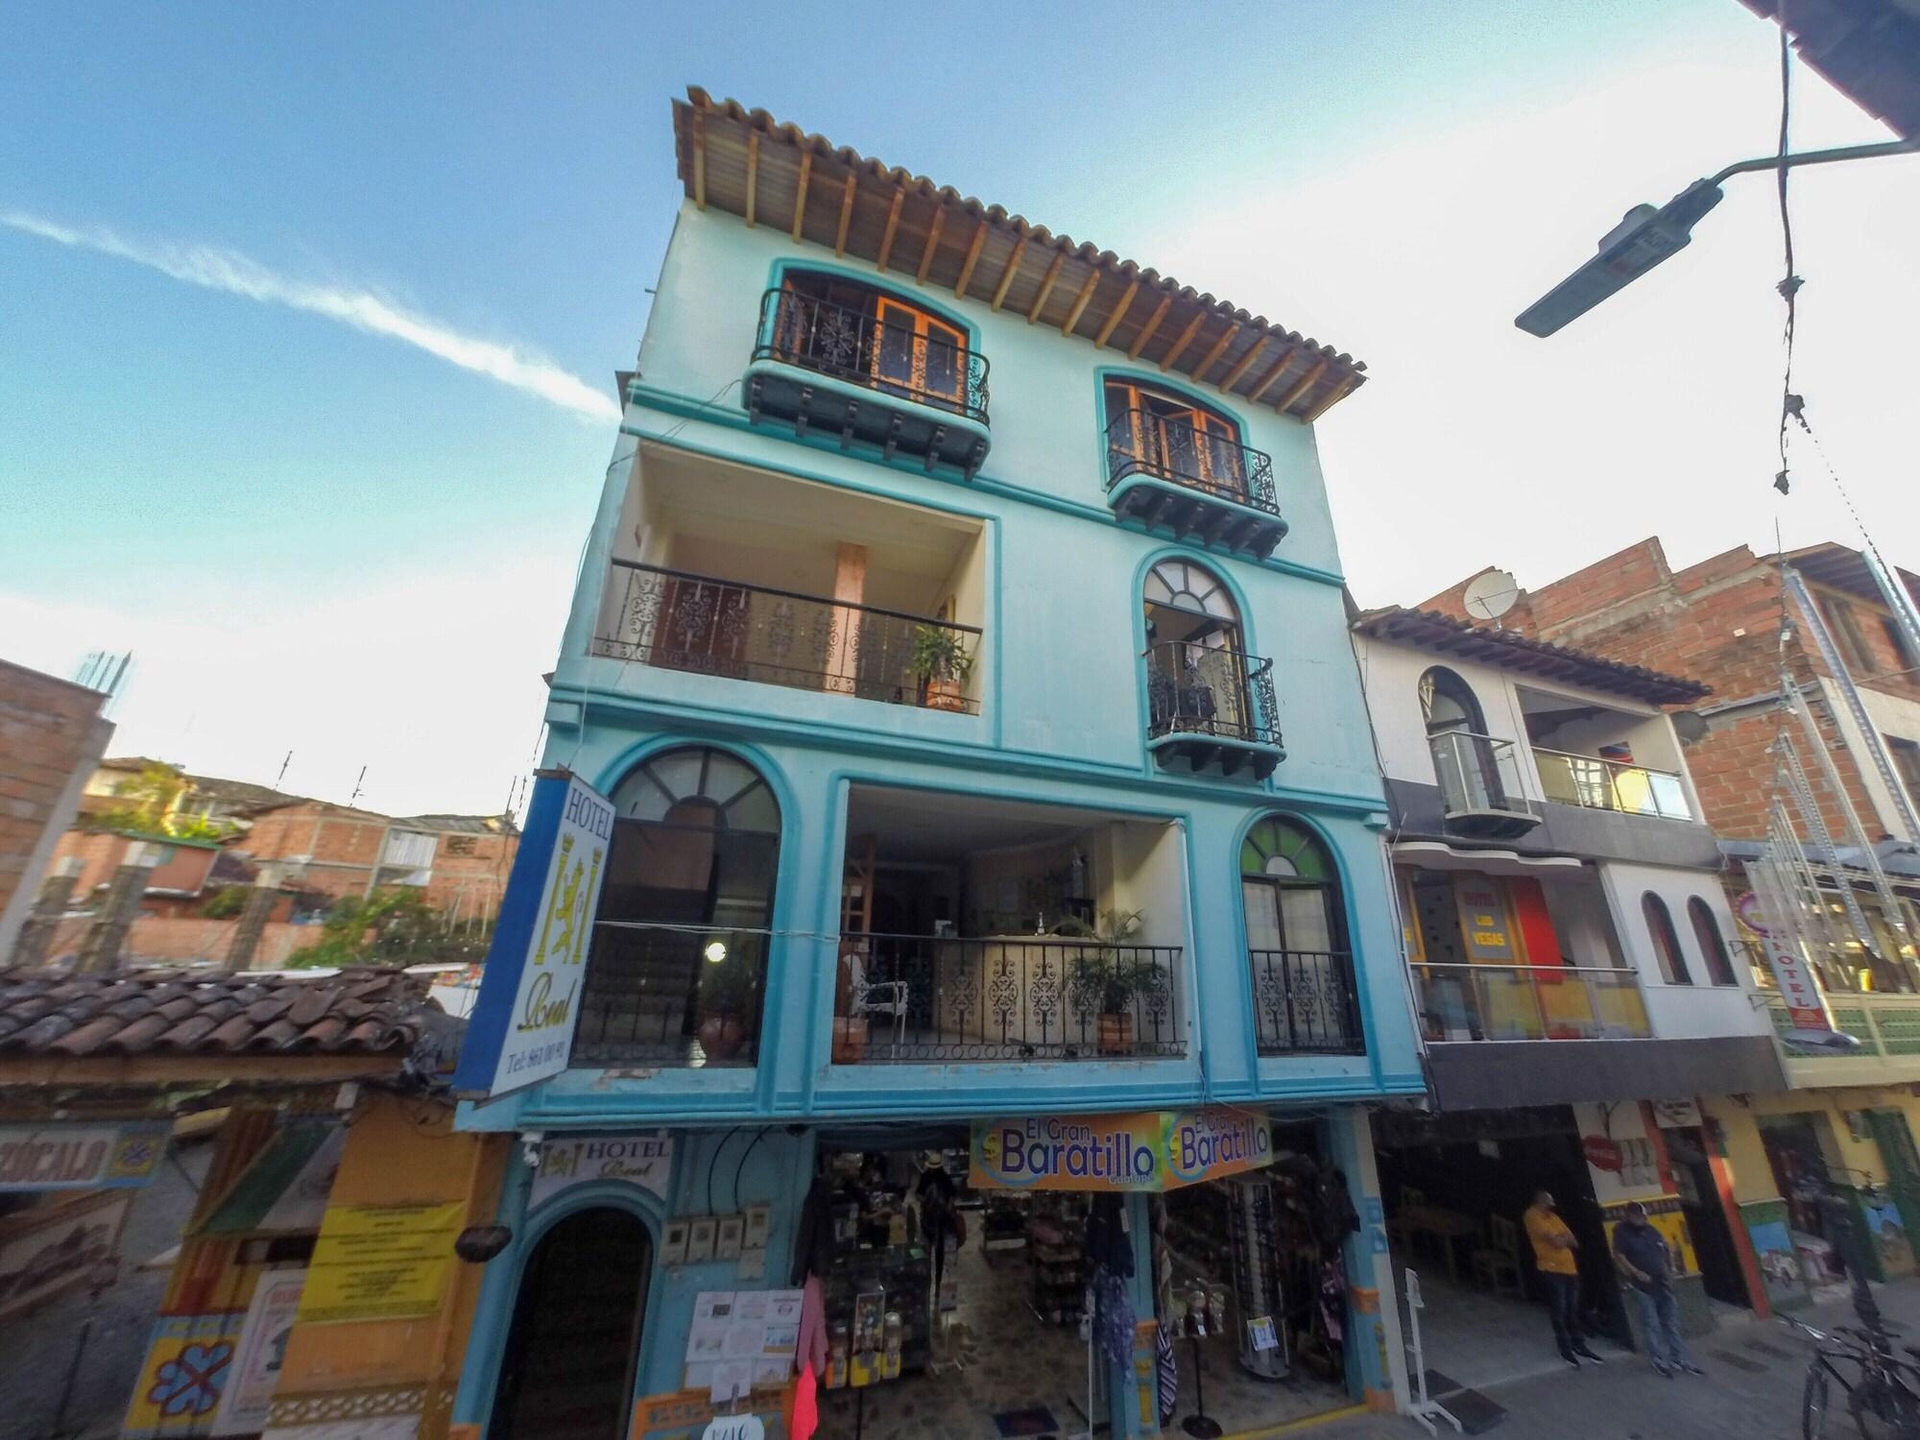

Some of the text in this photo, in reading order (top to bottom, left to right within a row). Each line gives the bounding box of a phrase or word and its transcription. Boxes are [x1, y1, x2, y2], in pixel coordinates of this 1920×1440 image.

[565, 786, 611, 840] HOTEL
[1472, 931, 1506, 946] VEGAS
[516, 971, 578, 1033] Real
[1026, 1118, 1090, 1142] El Gran
[1181, 1116, 1268, 1170] Baratillo
[586, 1141, 670, 1160] HOTEL
[598, 1160, 654, 1177] Real
[1001, 1128, 1154, 1176] Baratillo
